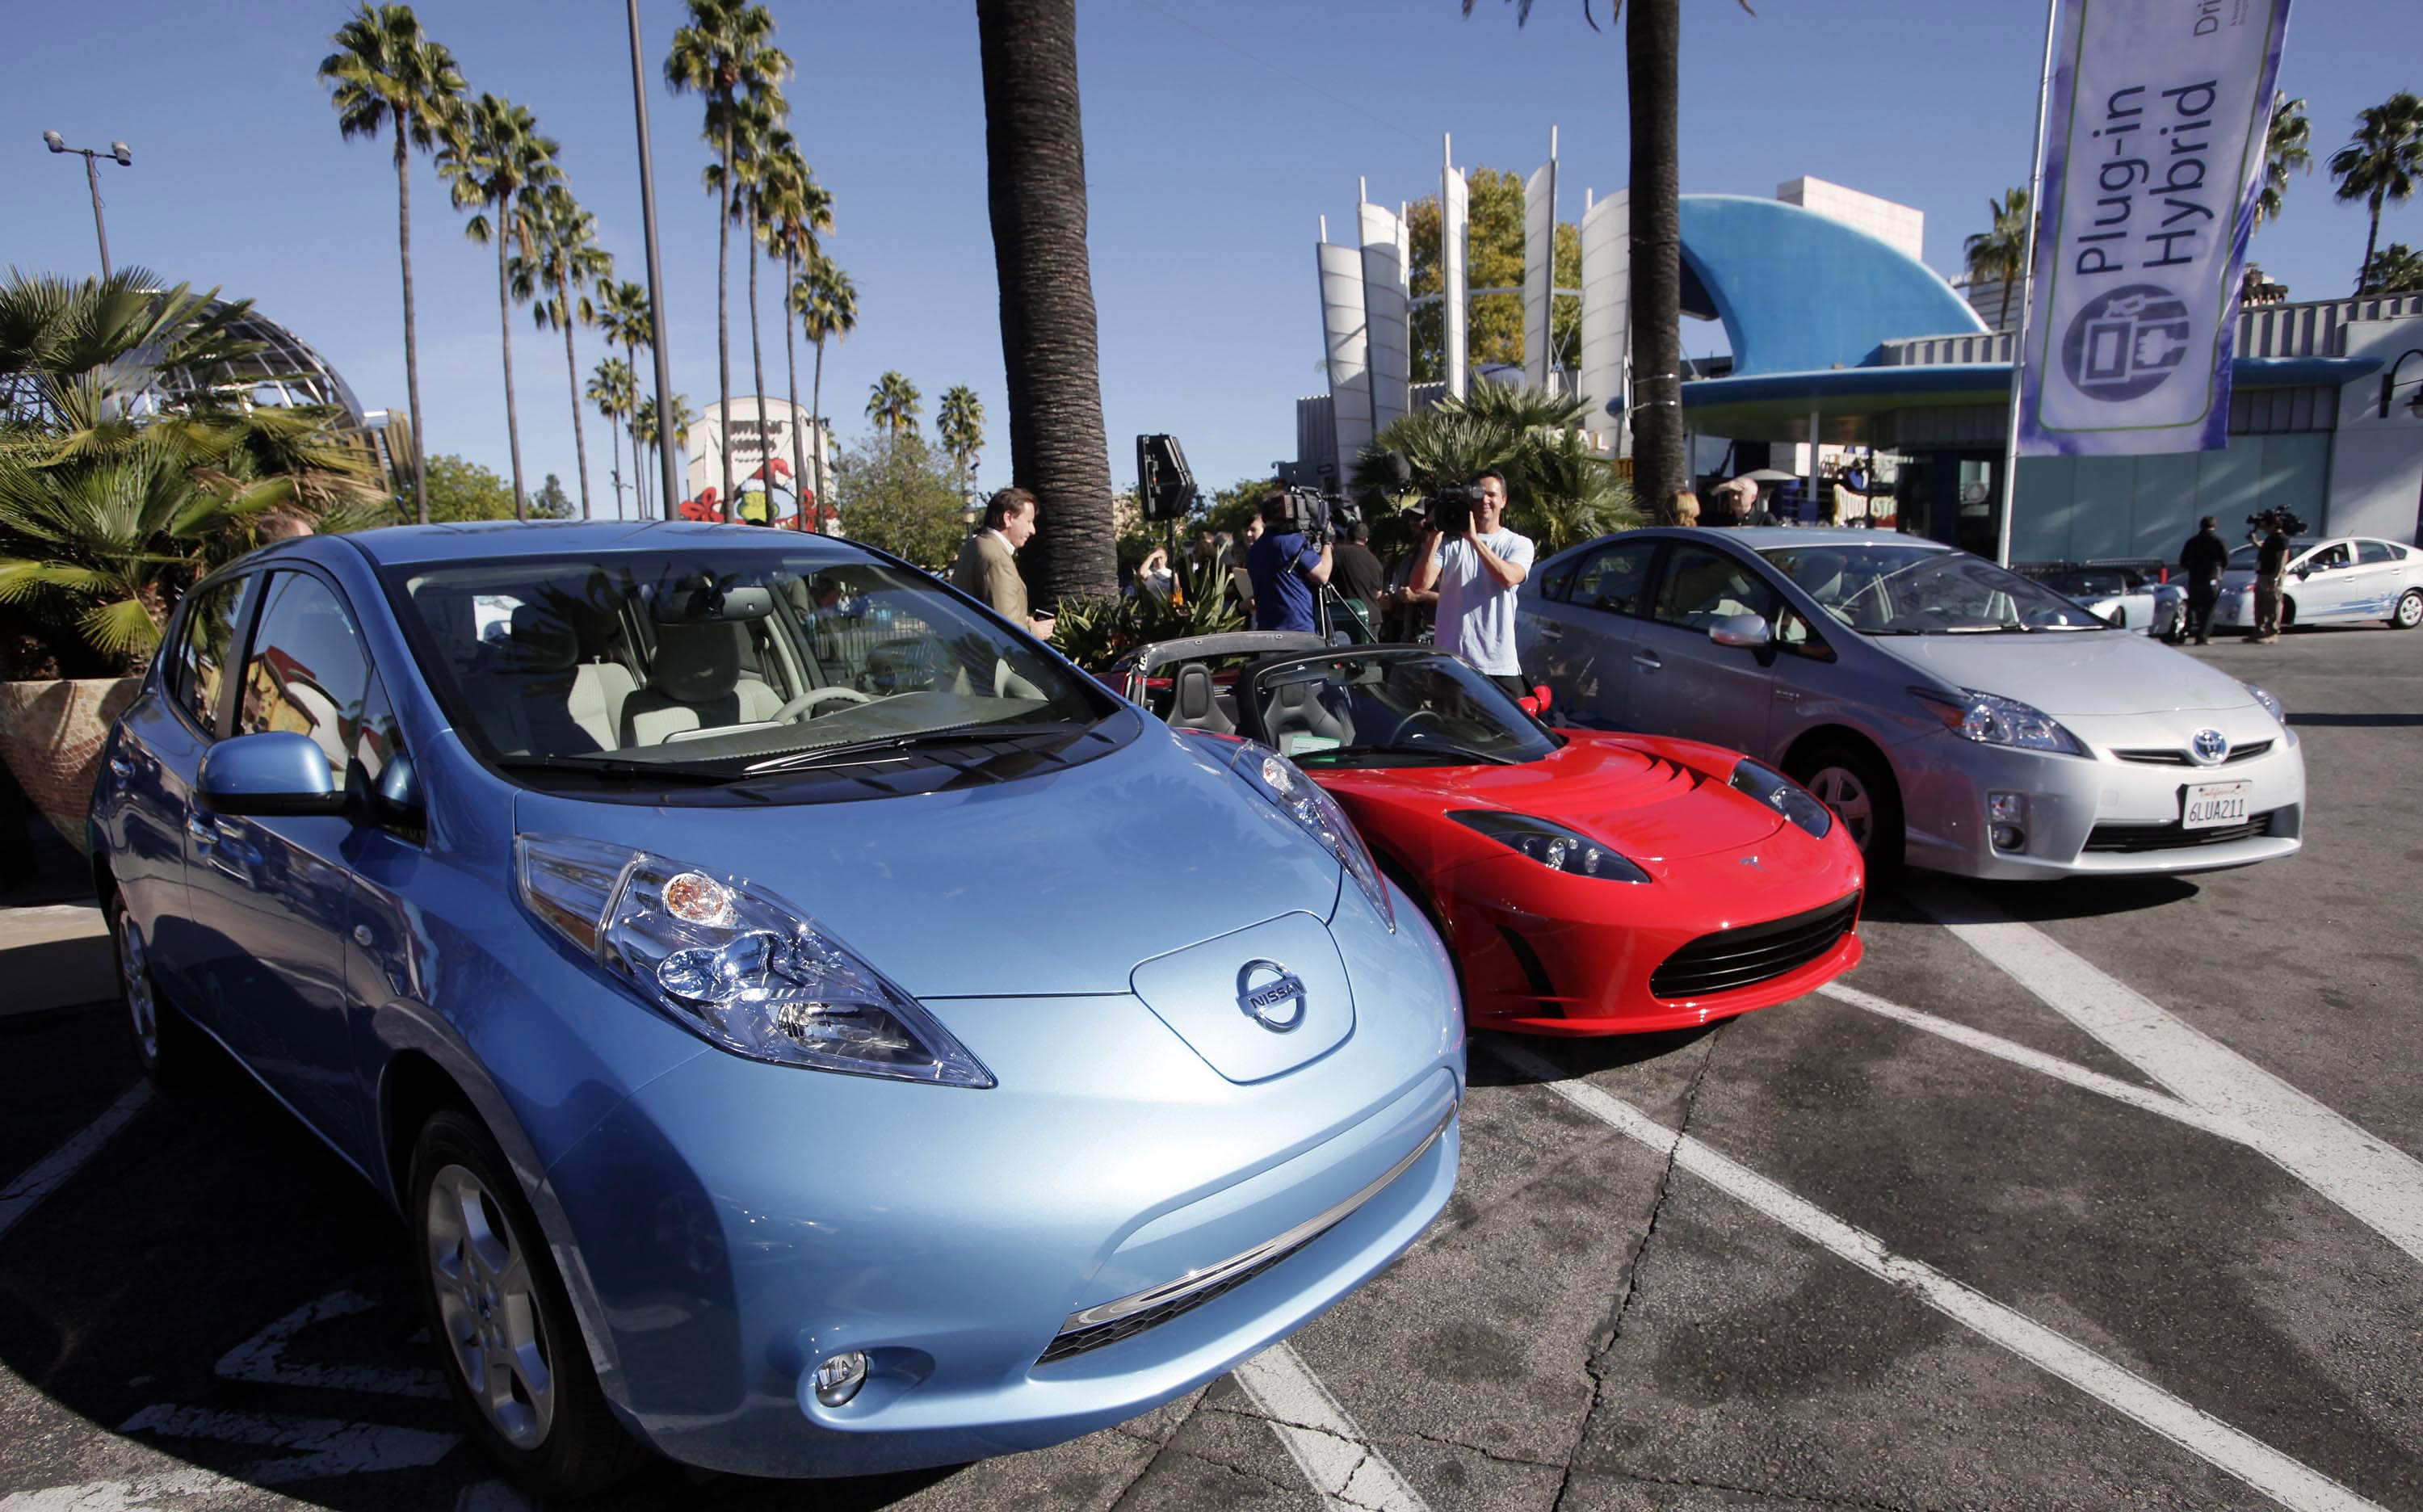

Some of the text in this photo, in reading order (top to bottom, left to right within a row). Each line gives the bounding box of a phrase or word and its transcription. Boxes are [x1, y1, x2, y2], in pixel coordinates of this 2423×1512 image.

[2076, 85, 2148, 275] Plug-in
[2143, 79, 2217, 267] Hybrid
[2190, 799, 2244, 821] 6LUA211
[1250, 981, 1305, 1009] NISSAN
